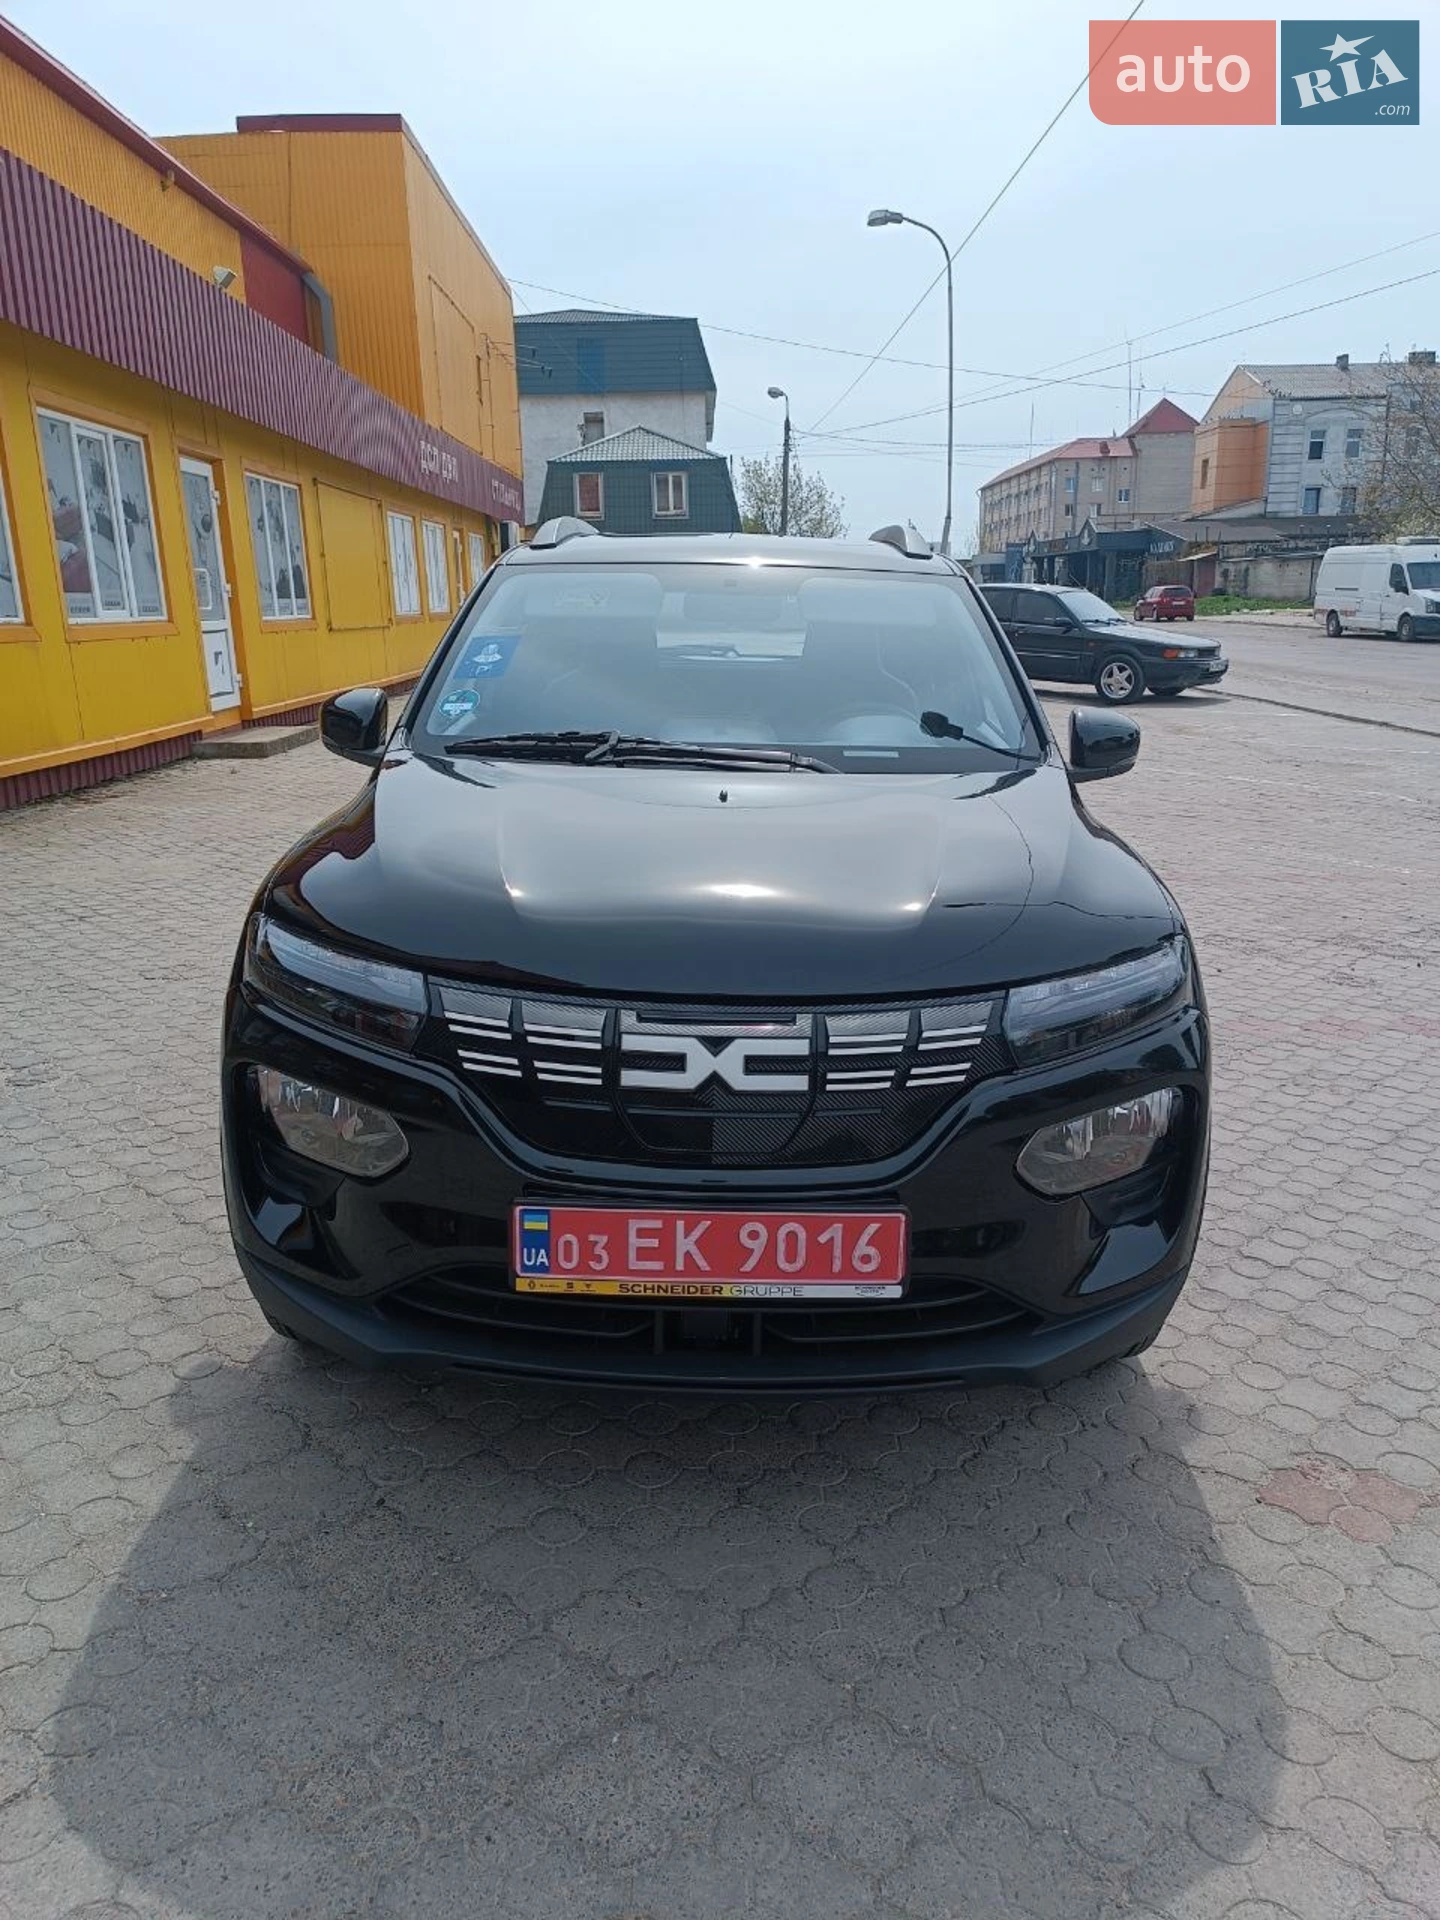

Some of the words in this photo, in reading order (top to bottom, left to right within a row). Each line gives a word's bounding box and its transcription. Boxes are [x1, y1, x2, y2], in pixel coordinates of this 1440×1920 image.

[557, 1233, 609, 1270] 03
[627, 1218, 712, 1272] EK
[738, 1221, 882, 1273] 9016
[523, 1247, 549, 1267] UA
[618, 1282, 724, 1296] SCHNEIDER
[729, 1285, 805, 1297] GRUPPE
